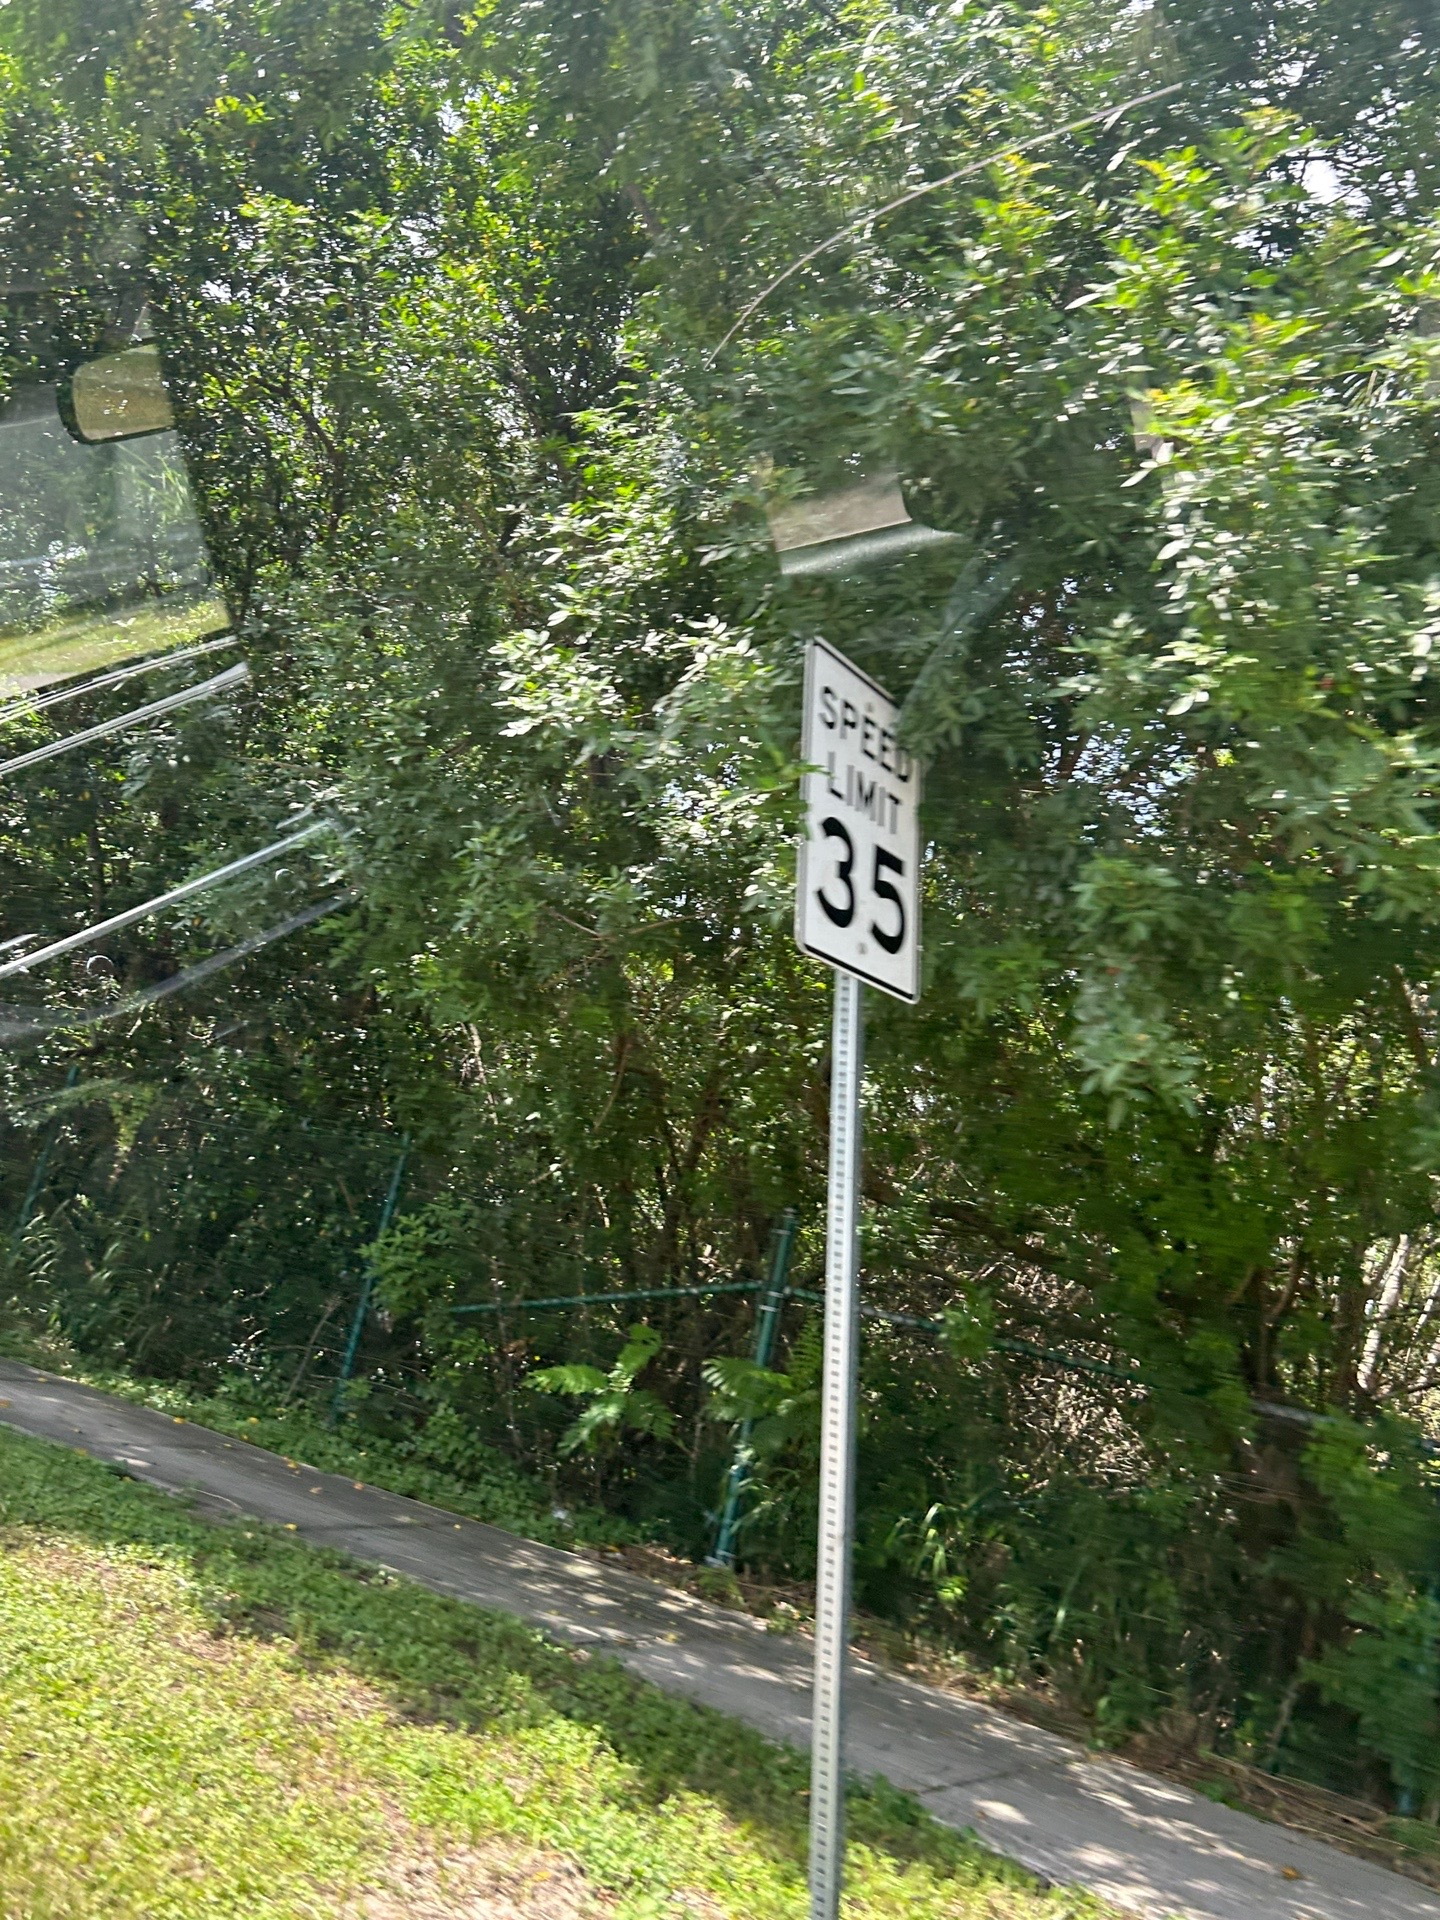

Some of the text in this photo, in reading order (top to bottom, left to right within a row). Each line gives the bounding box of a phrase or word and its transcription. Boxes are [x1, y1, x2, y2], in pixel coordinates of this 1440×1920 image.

[818, 686, 913, 783] SPEED
[827, 751, 902, 834] LIMIT
[816, 816, 906, 955] 35
